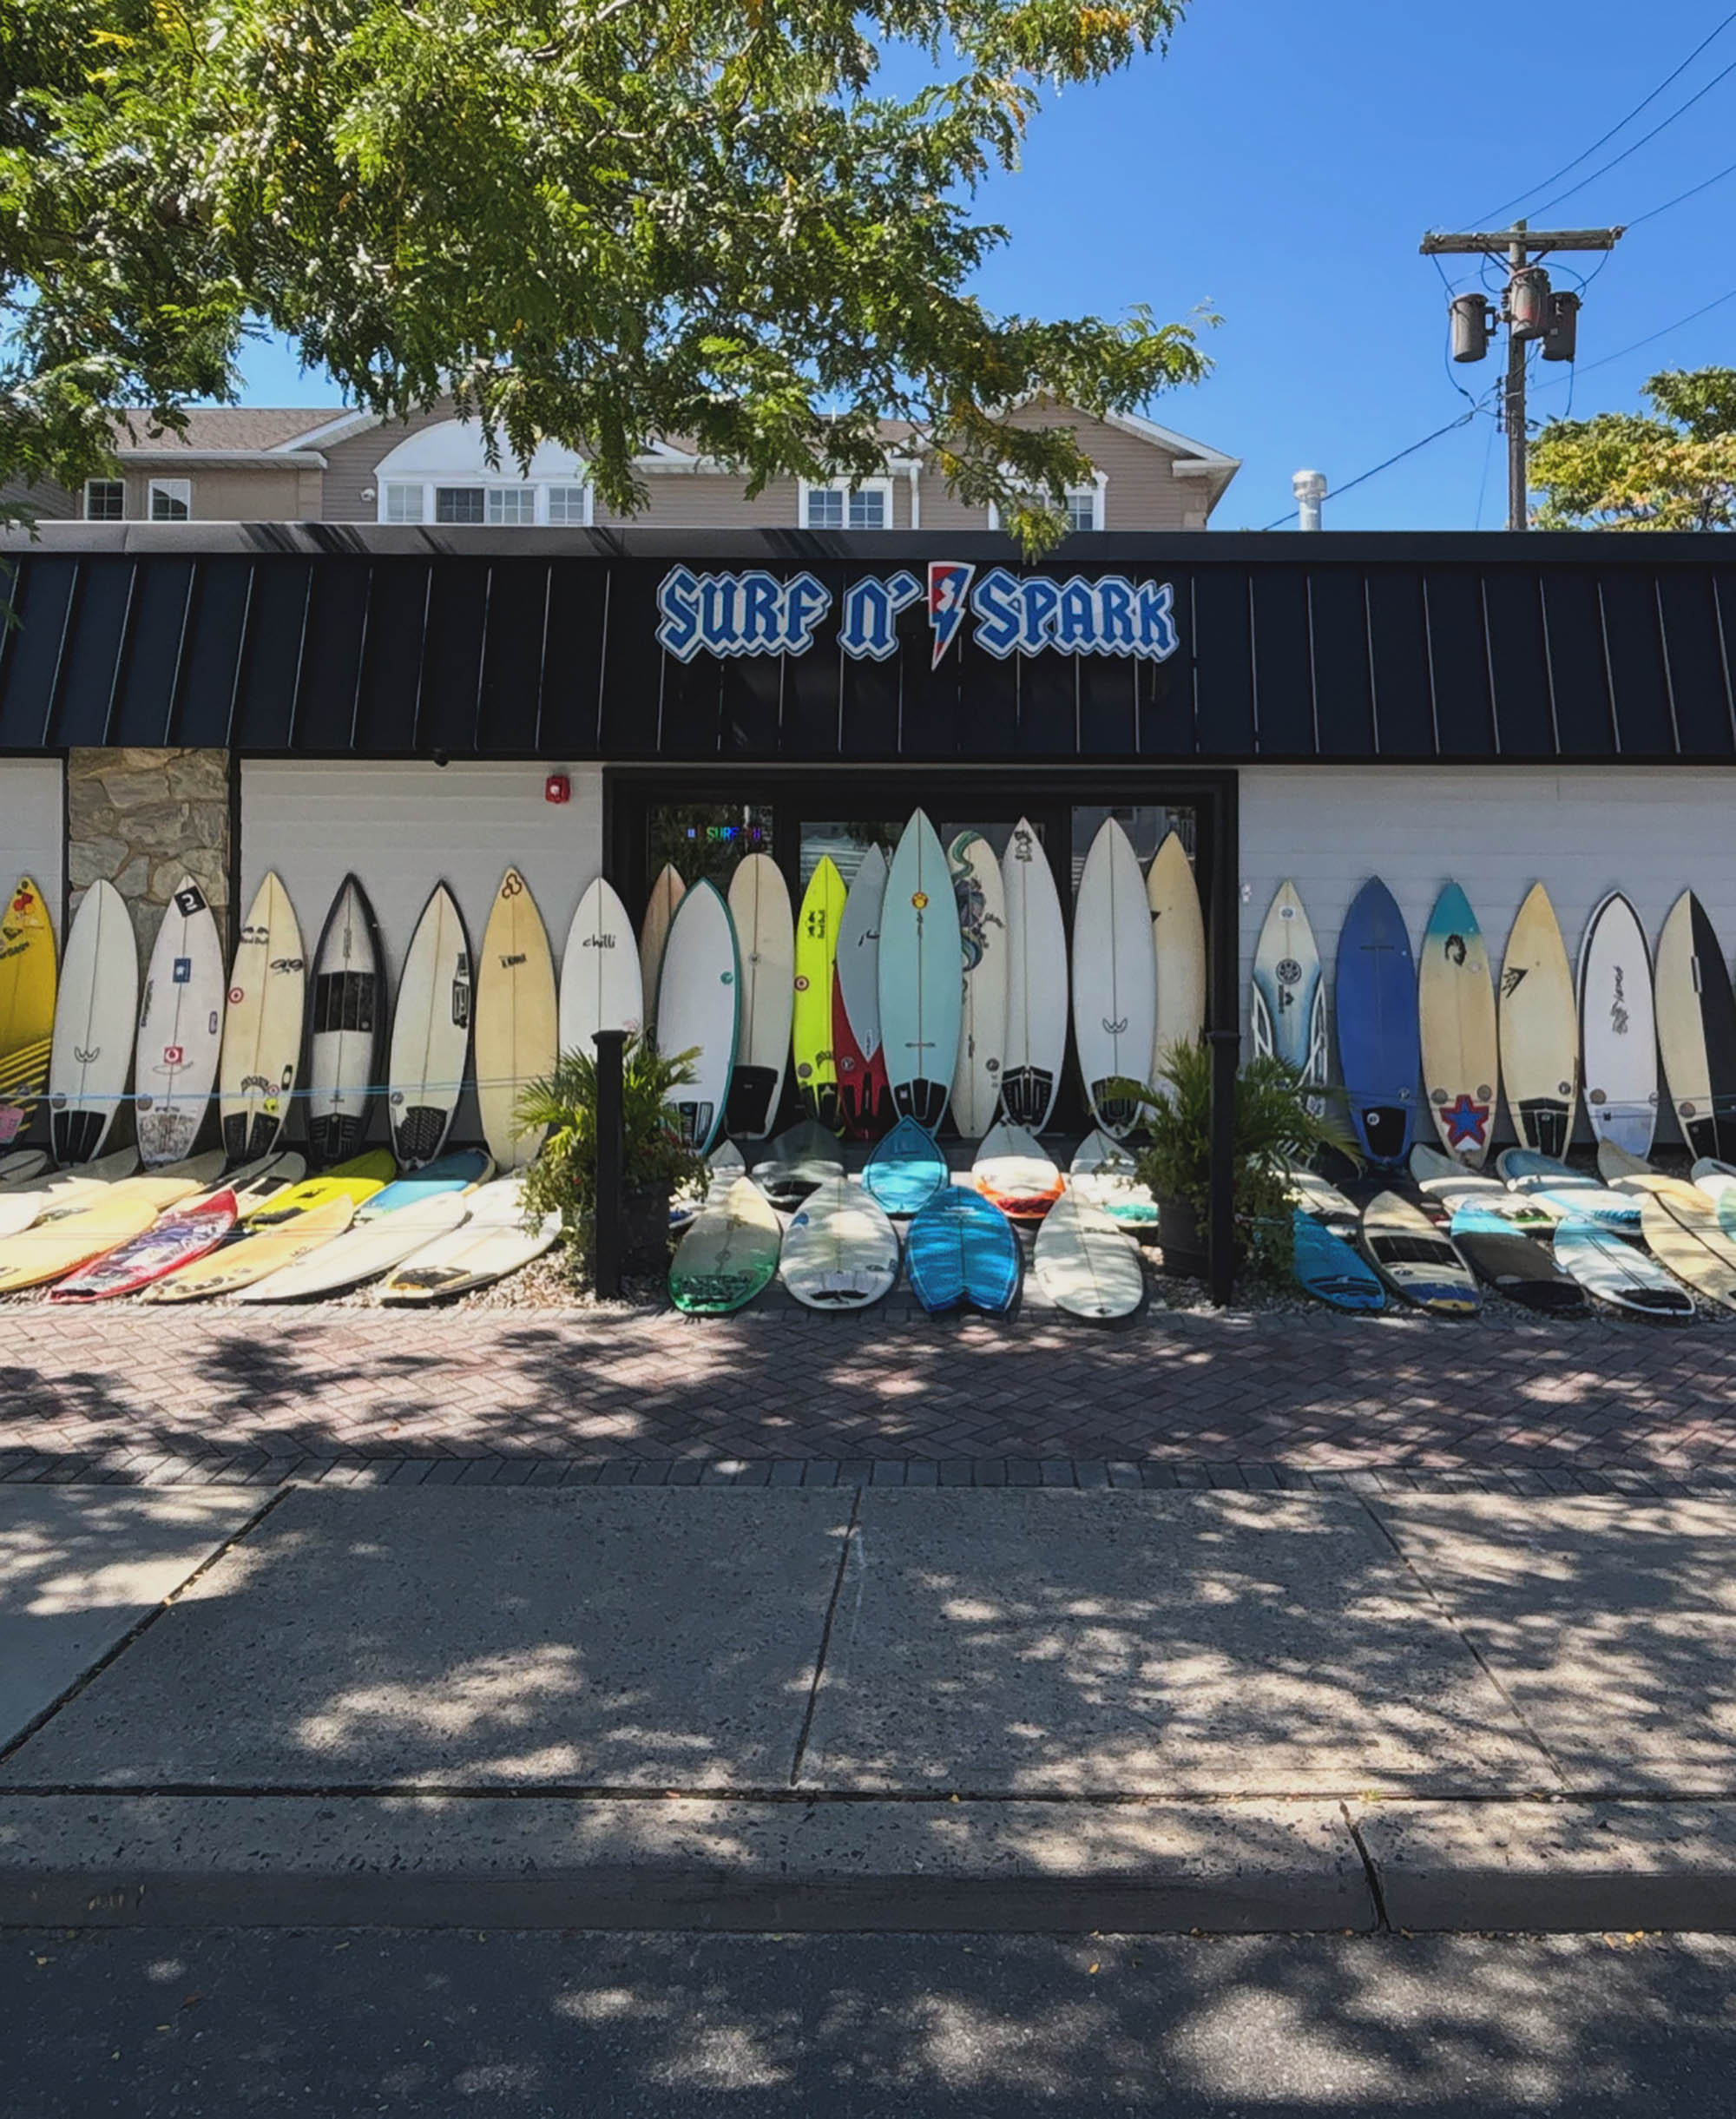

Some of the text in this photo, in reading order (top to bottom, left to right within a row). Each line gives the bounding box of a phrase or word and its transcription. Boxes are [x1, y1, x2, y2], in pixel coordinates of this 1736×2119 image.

[661, 568, 827, 657] SURF
[976, 570, 1176, 658] SPARK
[707, 826, 738, 841] SURF
